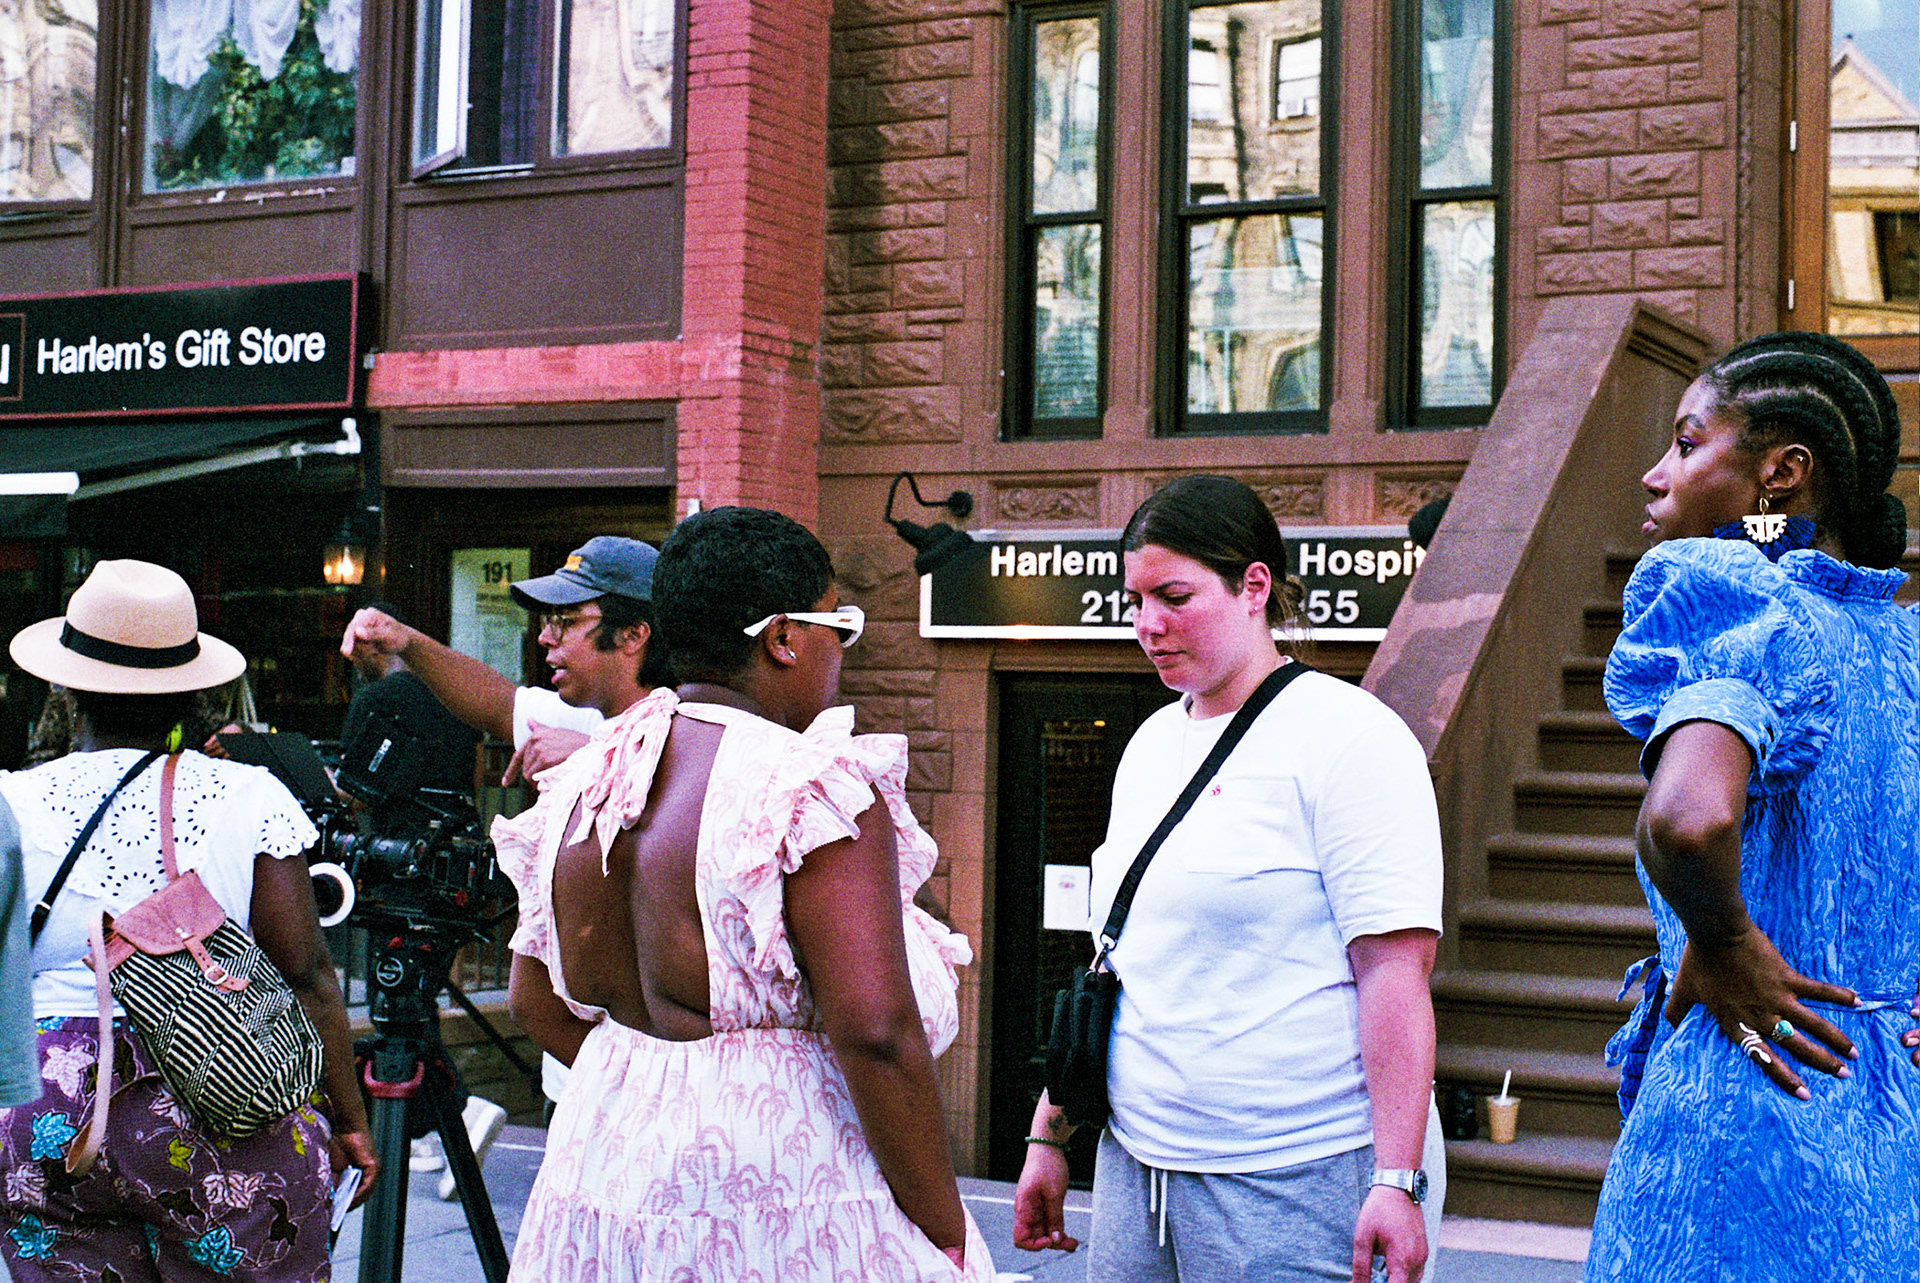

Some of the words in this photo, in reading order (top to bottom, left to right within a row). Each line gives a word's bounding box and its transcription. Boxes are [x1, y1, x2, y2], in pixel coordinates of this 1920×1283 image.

[37, 333, 167, 375] Harlem's
[175, 328, 231, 368] Gift
[238, 326, 326, 366] Store
[482, 562, 512, 583] 191
[990, 544, 1118, 577] Harlem
[1299, 589, 1360, 624] 55
